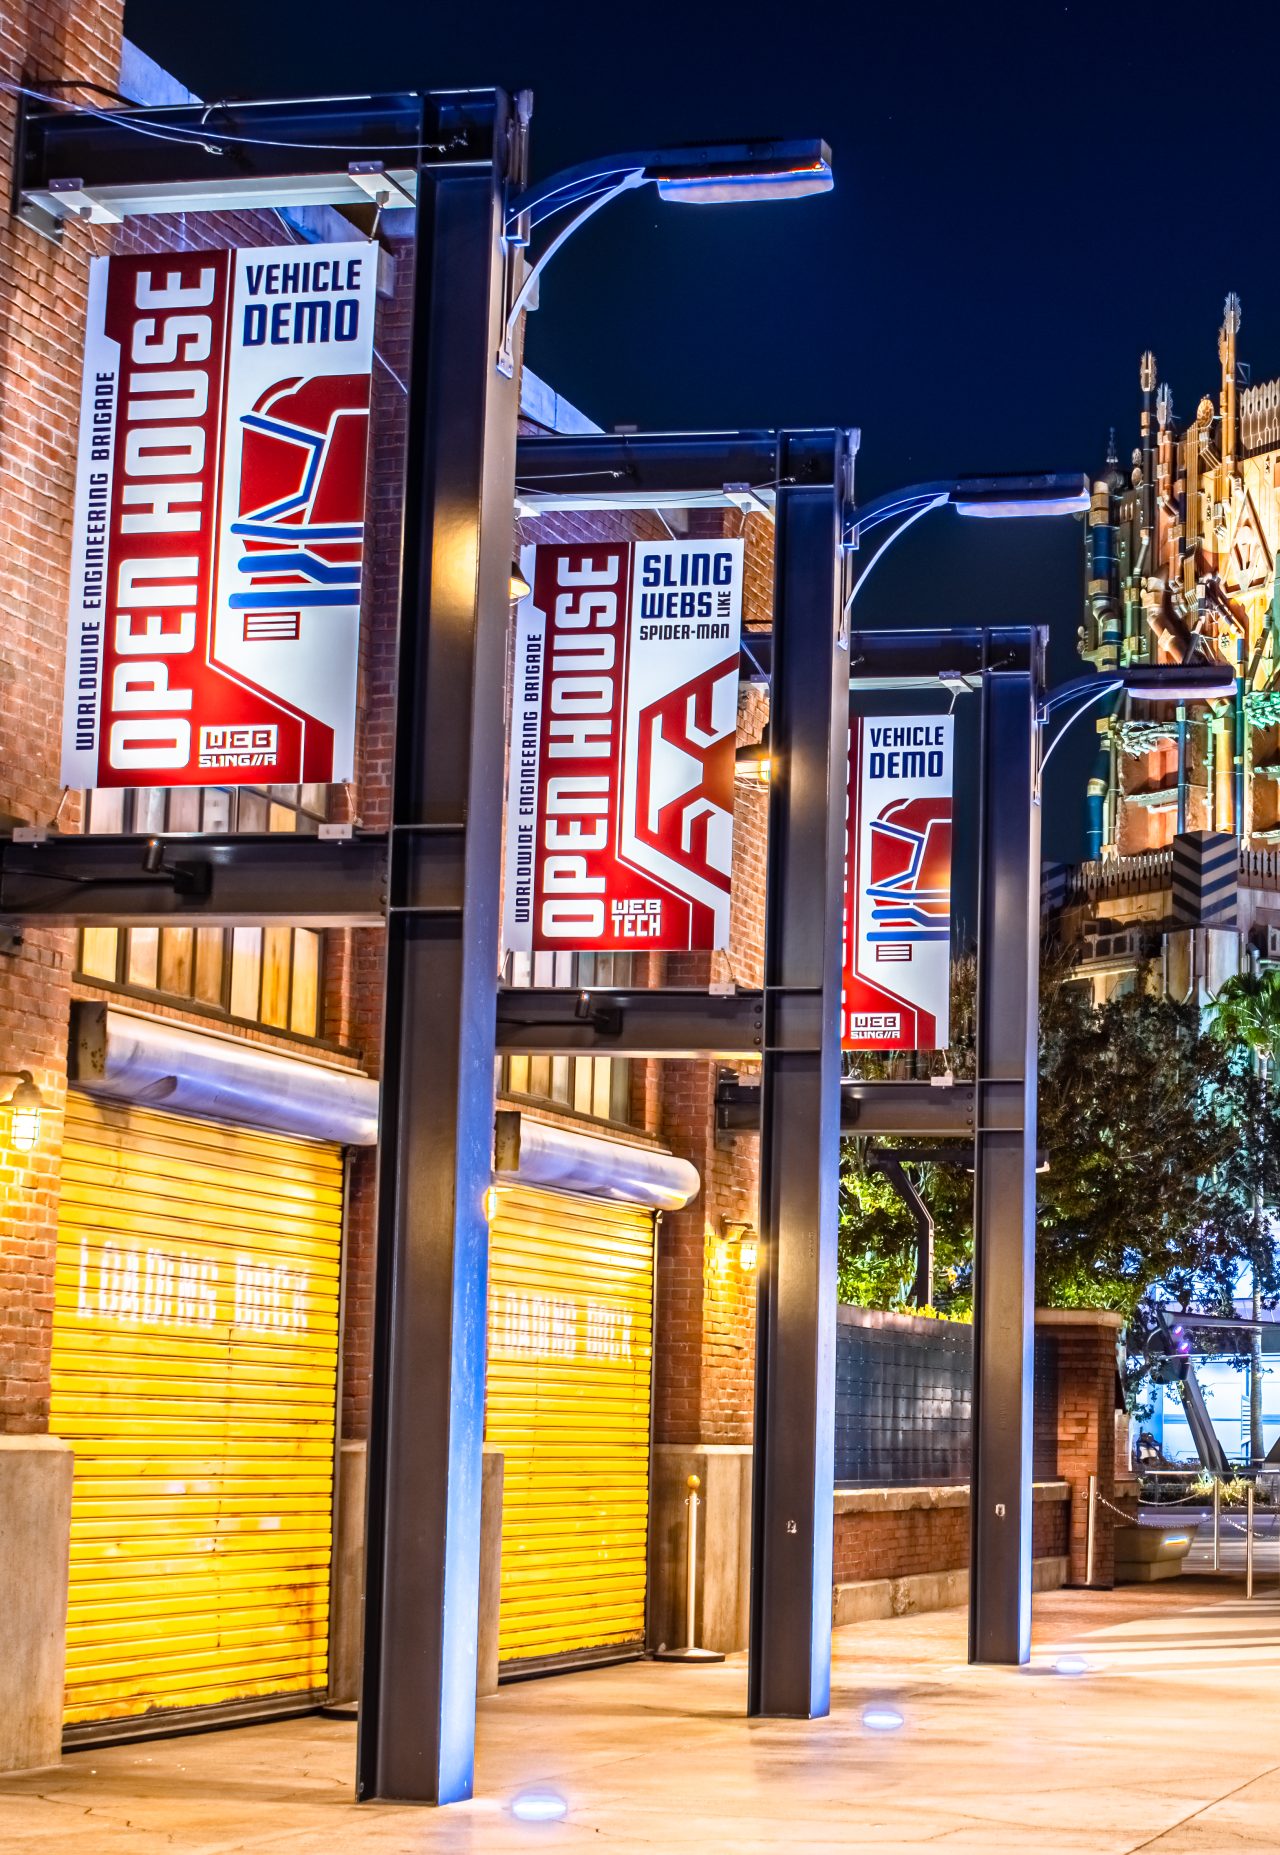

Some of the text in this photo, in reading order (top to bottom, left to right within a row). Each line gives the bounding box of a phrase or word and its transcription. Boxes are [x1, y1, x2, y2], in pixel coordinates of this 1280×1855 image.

[245, 259, 363, 296] VEHICLE
[242, 298, 360, 347] DEMO
[109, 266, 216, 770] OPEN HOUSE
[75, 370, 116, 752] WORLDWIDE ENGINEERING BRIGADE
[641, 551, 733, 588] SLING
[640, 590, 714, 620] WEBS
[716, 590, 732, 619] LIKE
[639, 622, 731, 642] SPIDER-MAN
[204, 728, 274, 751] WEB
[541, 555, 620, 939] OPEN HOUSE
[869, 725, 945, 748] VEHICLE
[514, 632, 543, 924] WORLDWIDE ENGINEERING BRIGADE
[868, 750, 944, 779] DEMO
[611, 899, 662, 915] WEB
[611, 915, 662, 937] TECH
[853, 1015, 898, 1028] WEB
